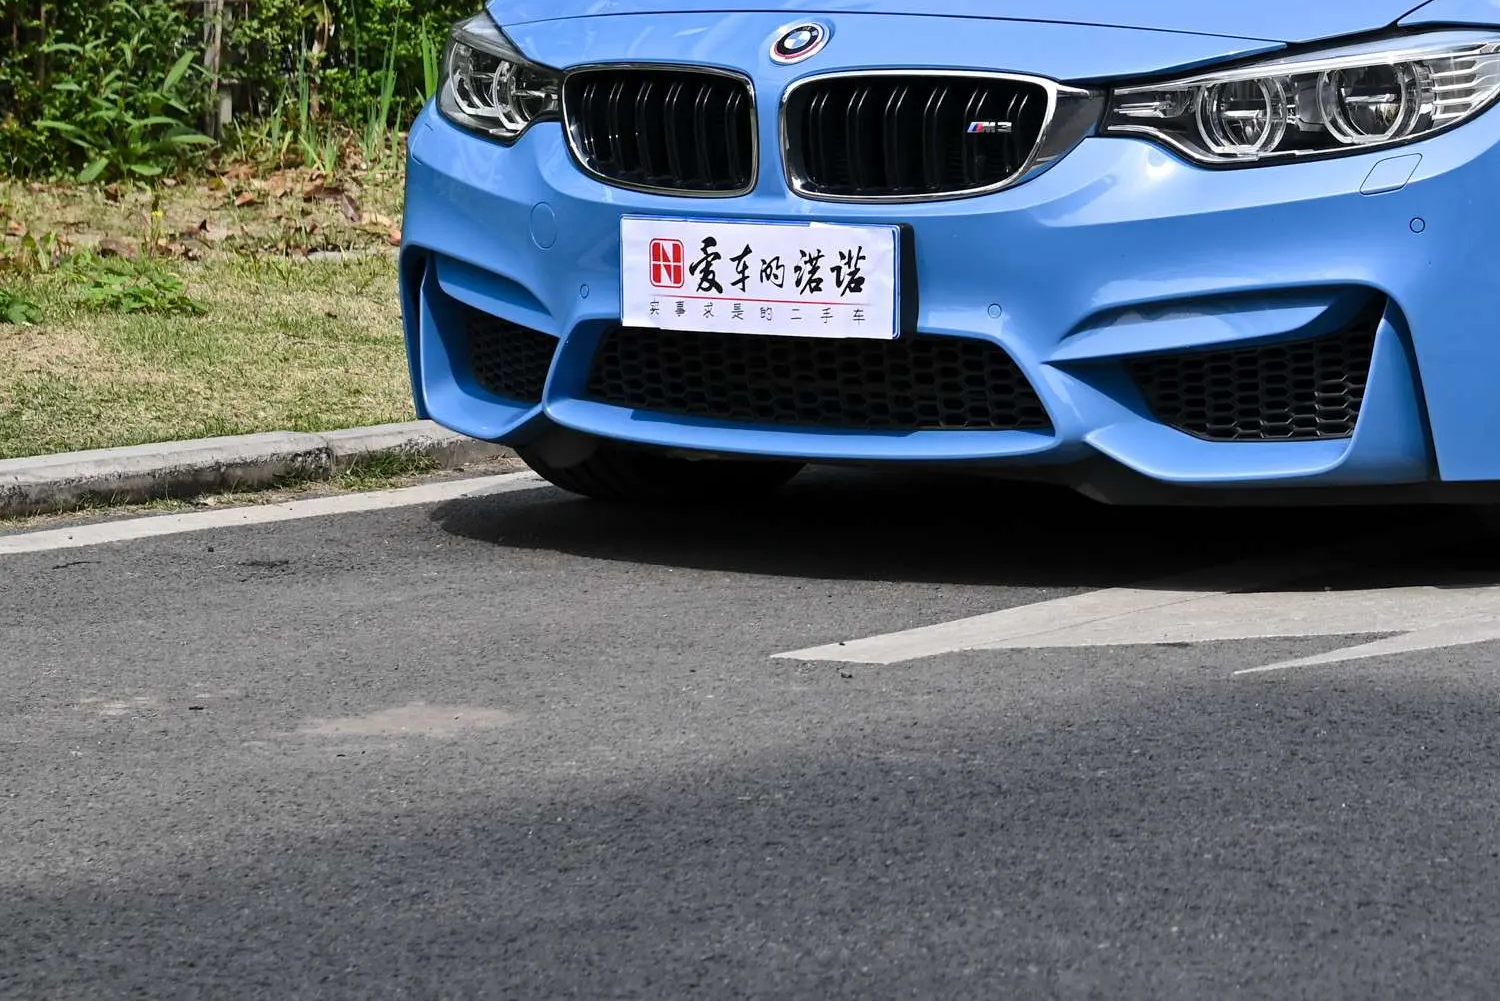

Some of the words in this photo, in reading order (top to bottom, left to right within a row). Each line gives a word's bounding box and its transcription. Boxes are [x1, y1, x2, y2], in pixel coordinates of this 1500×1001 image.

[974, 121, 1012, 133] M3
[649, 297, 866, 326] 实事求是的二手车
